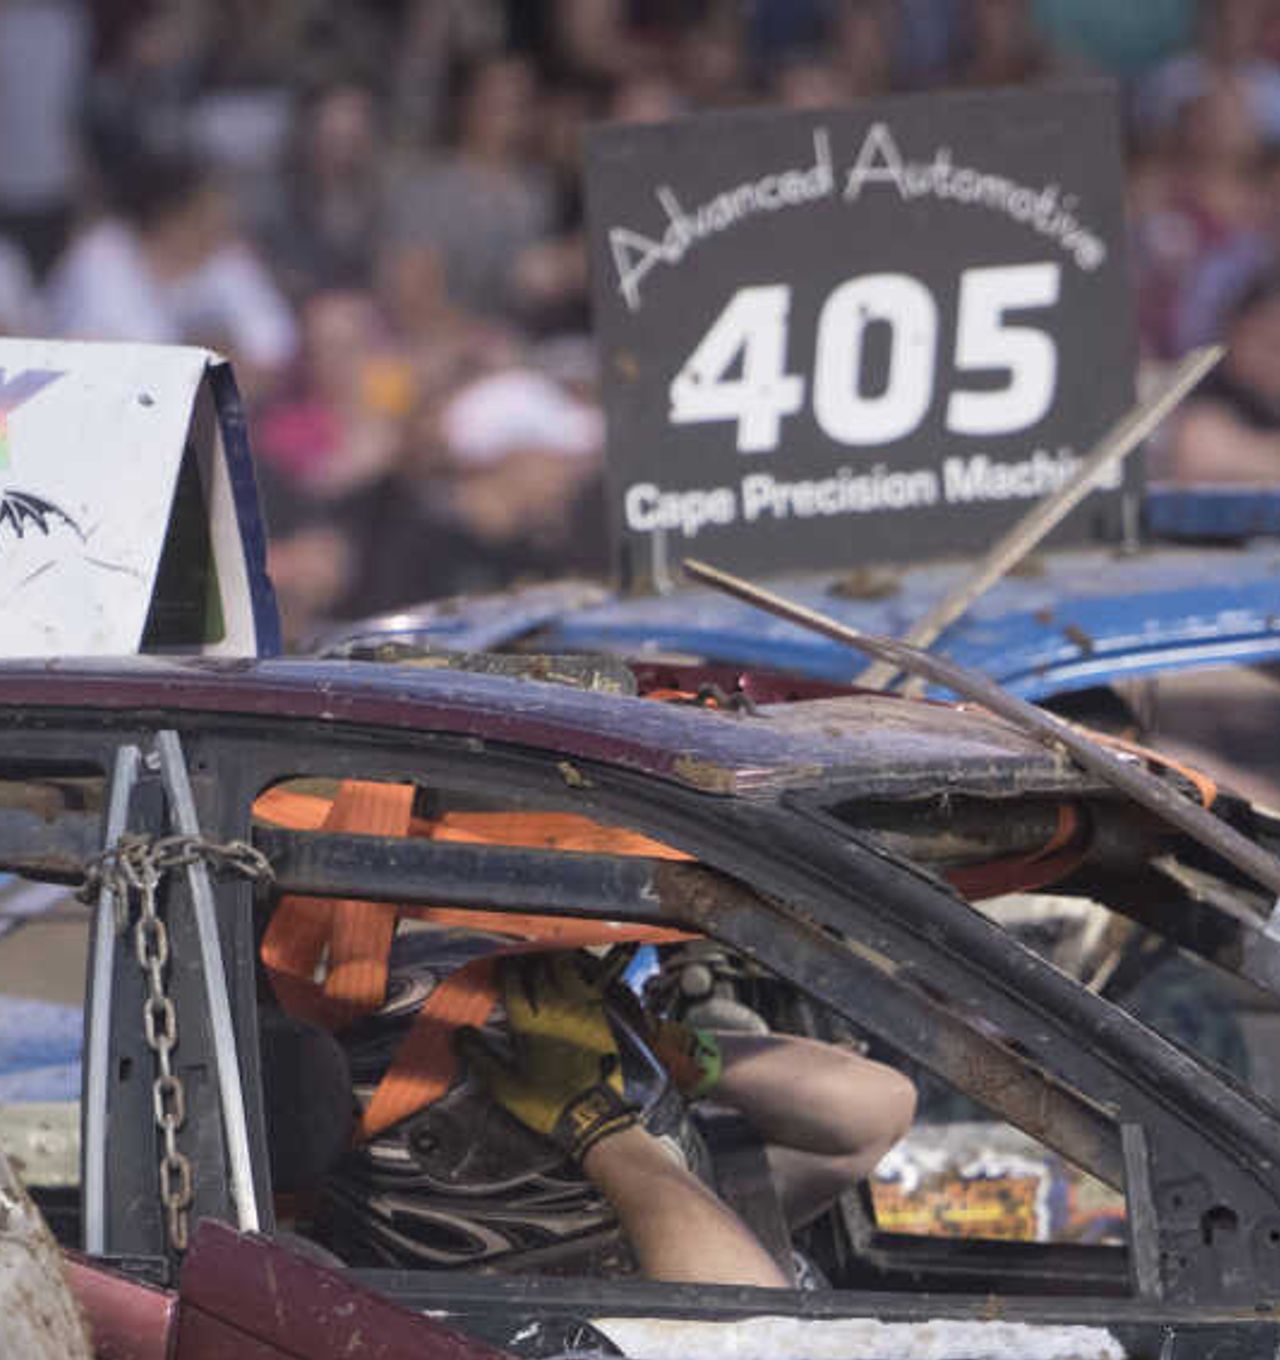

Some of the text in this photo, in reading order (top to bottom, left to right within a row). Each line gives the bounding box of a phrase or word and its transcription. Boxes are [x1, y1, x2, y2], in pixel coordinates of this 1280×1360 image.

[608, 123, 1106, 310] Advanced Automotive
[669, 263, 1061, 453] 405
[624, 449, 1124, 537] Cape Precision Machie
